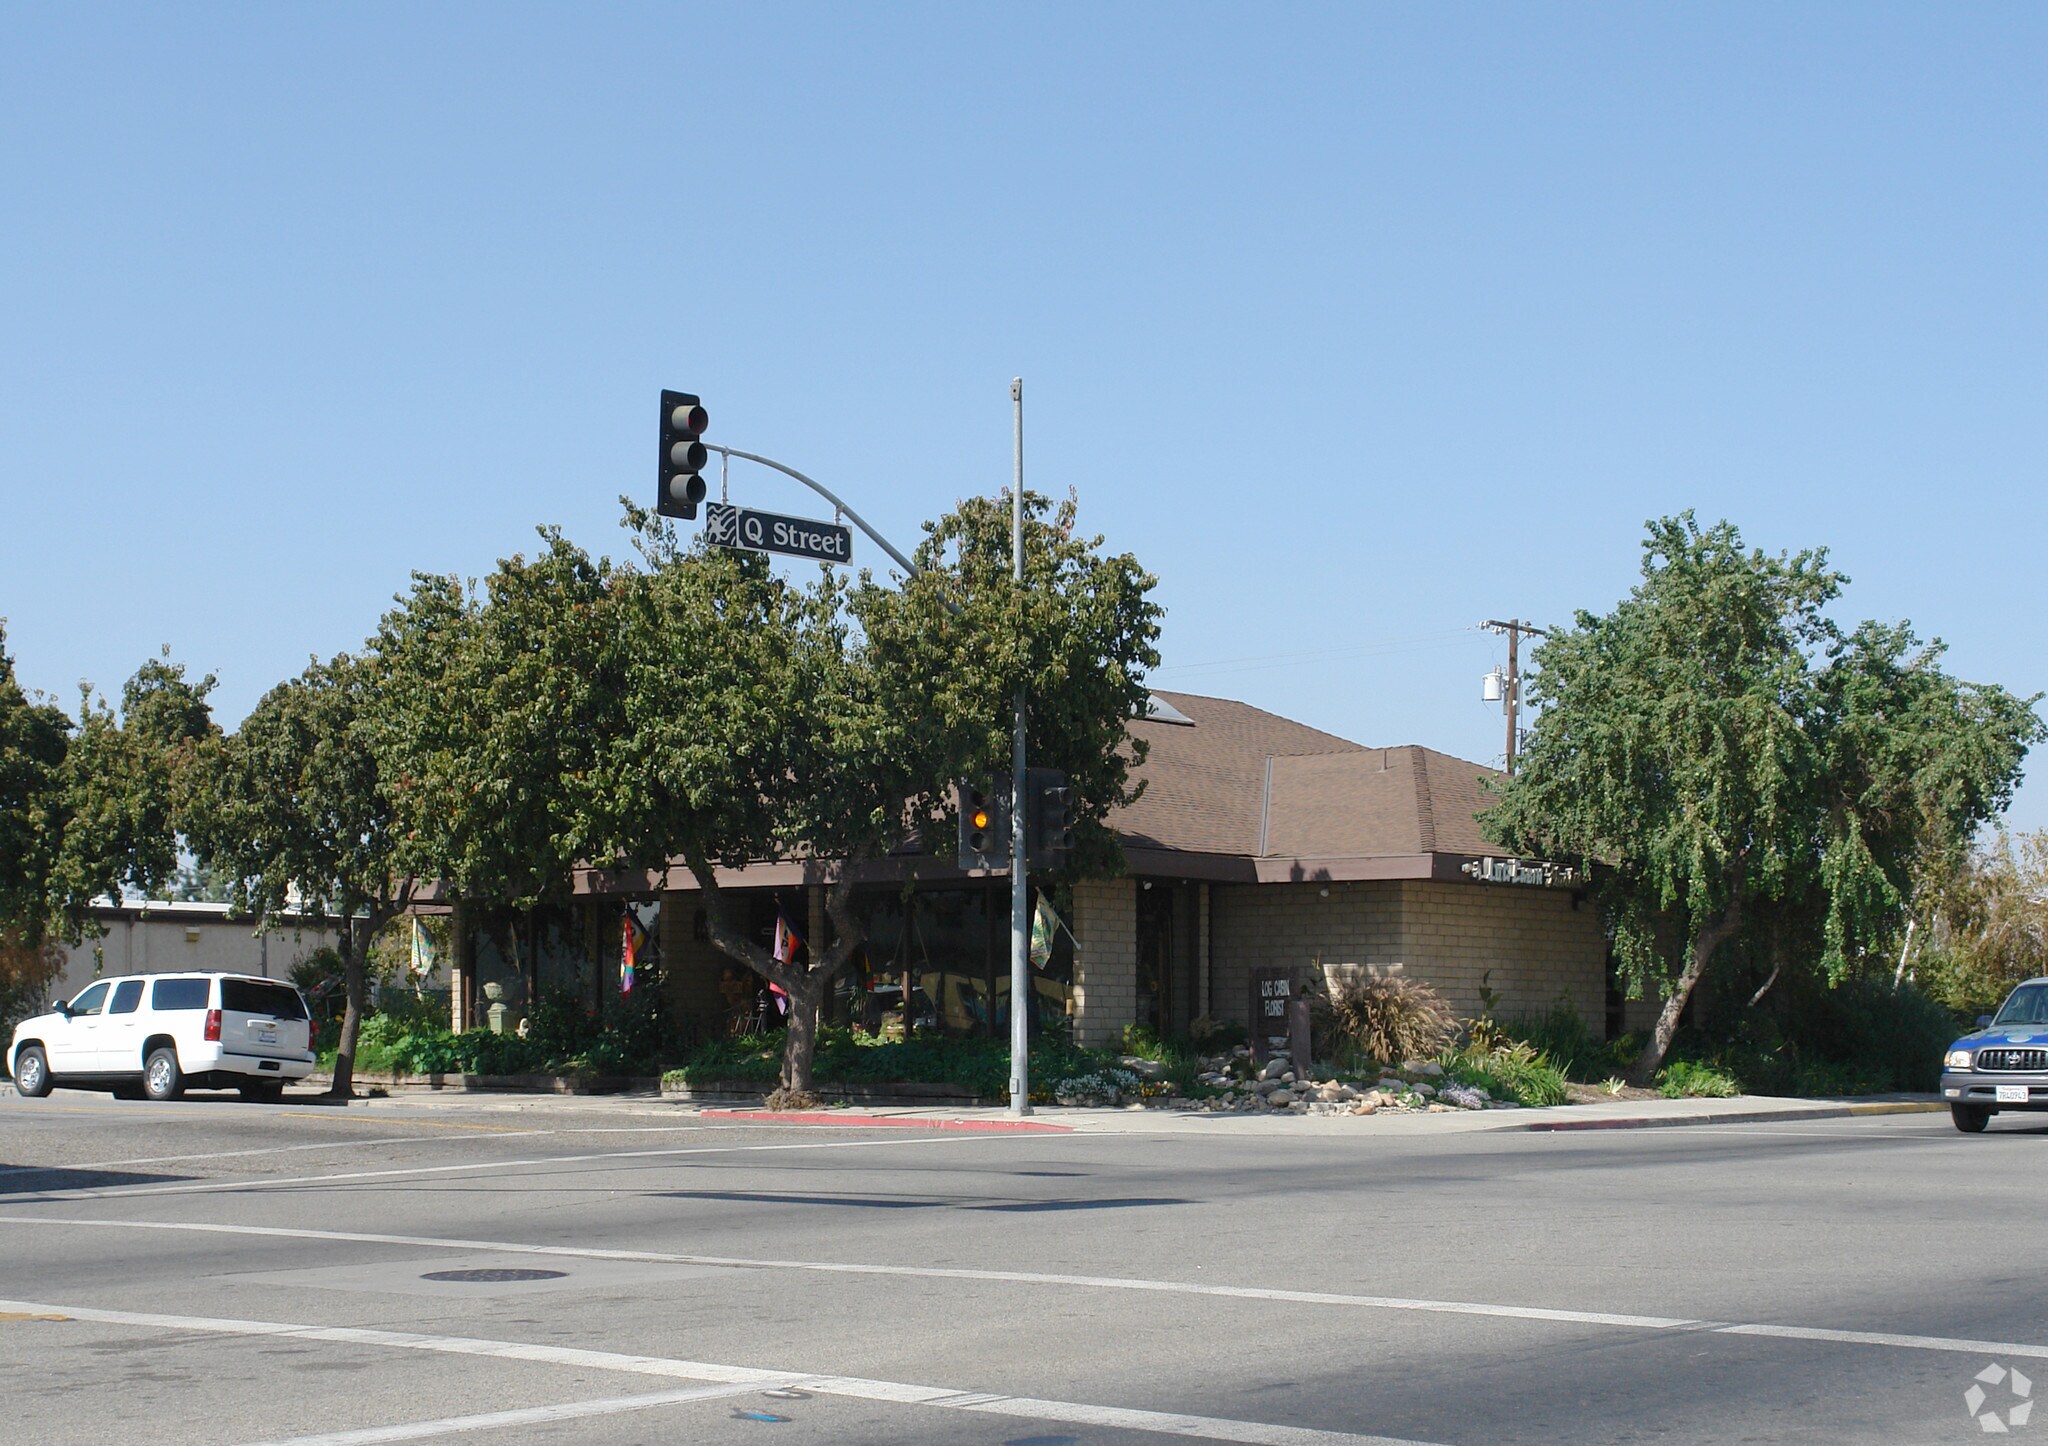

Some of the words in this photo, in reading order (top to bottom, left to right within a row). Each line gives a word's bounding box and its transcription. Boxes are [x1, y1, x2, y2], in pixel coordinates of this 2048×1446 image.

[744, 517, 763, 545] Q
[773, 522, 844, 555] Street
[1261, 980, 1272, 997] LOG
[1274, 979, 1290, 996] CABIN
[1264, 1000, 1285, 1016] FLORIST
